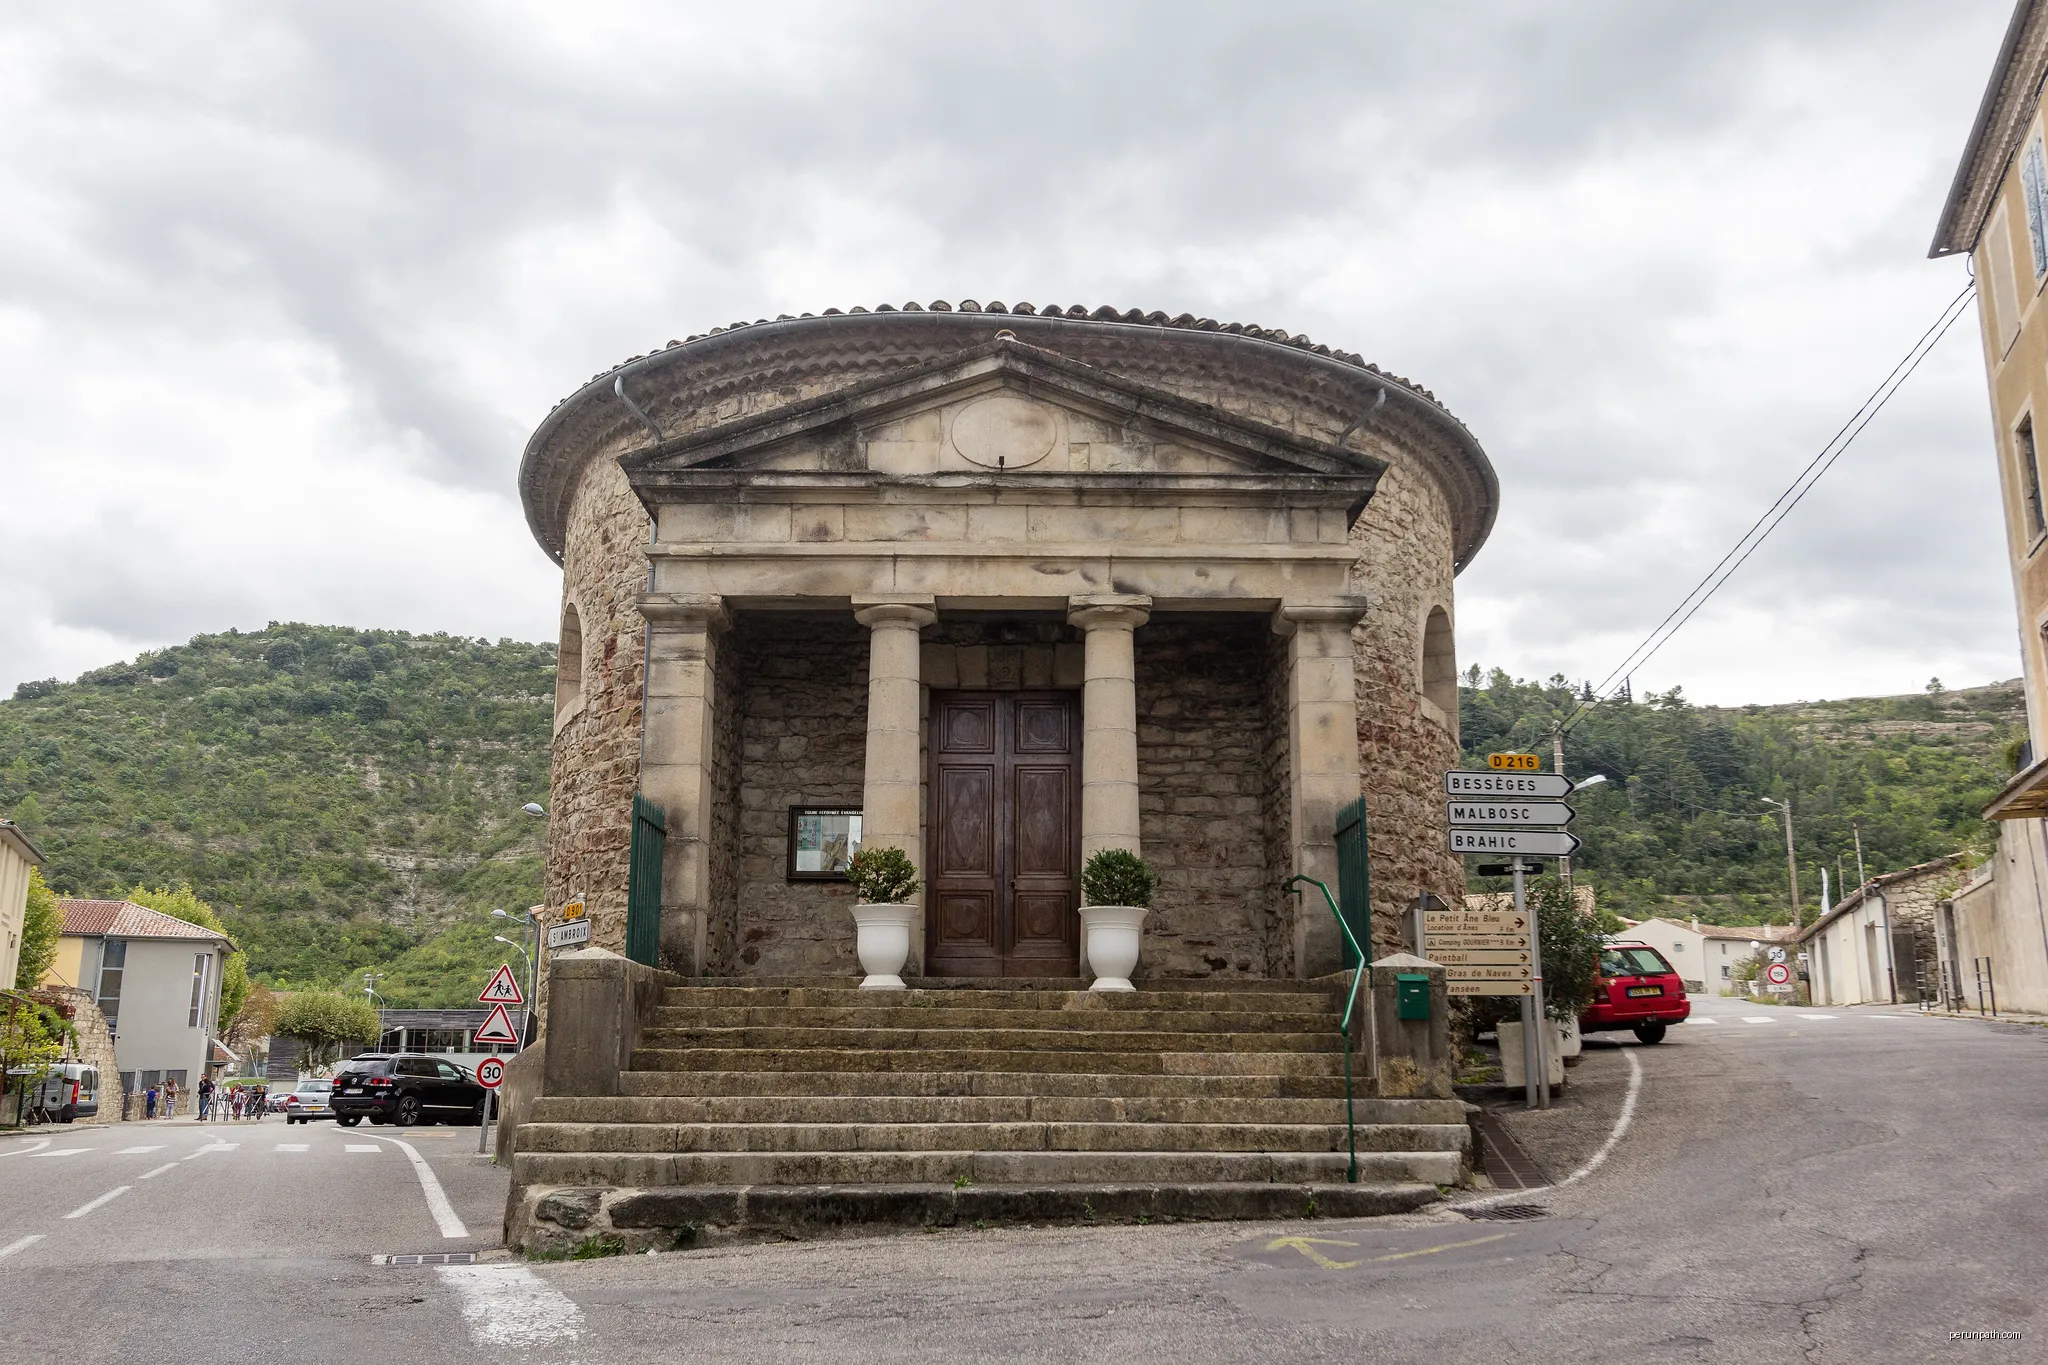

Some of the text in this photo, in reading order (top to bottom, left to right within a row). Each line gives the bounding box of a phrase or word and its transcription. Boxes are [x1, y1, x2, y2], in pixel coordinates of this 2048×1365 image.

[1493, 755, 1535, 768] D 216
[1452, 776, 1536, 791] BESSÈGES
[1454, 807, 1530, 820] MALBOSC
[1455, 835, 1517, 849] BRAHIC
[1426, 914, 1436, 923] Le
[1439, 914, 1460, 923] Petit
[1482, 914, 1500, 923] Bleu
[560, 926, 587, 941] AMBROIX
[1438, 938, 1461, 947] Camping
[1428, 953, 1468, 962] Paintball
[1771, 951, 1782, 959] 30
[1447, 969, 1512, 977] Gras de Naves
[483, 1066, 501, 1079] 30
